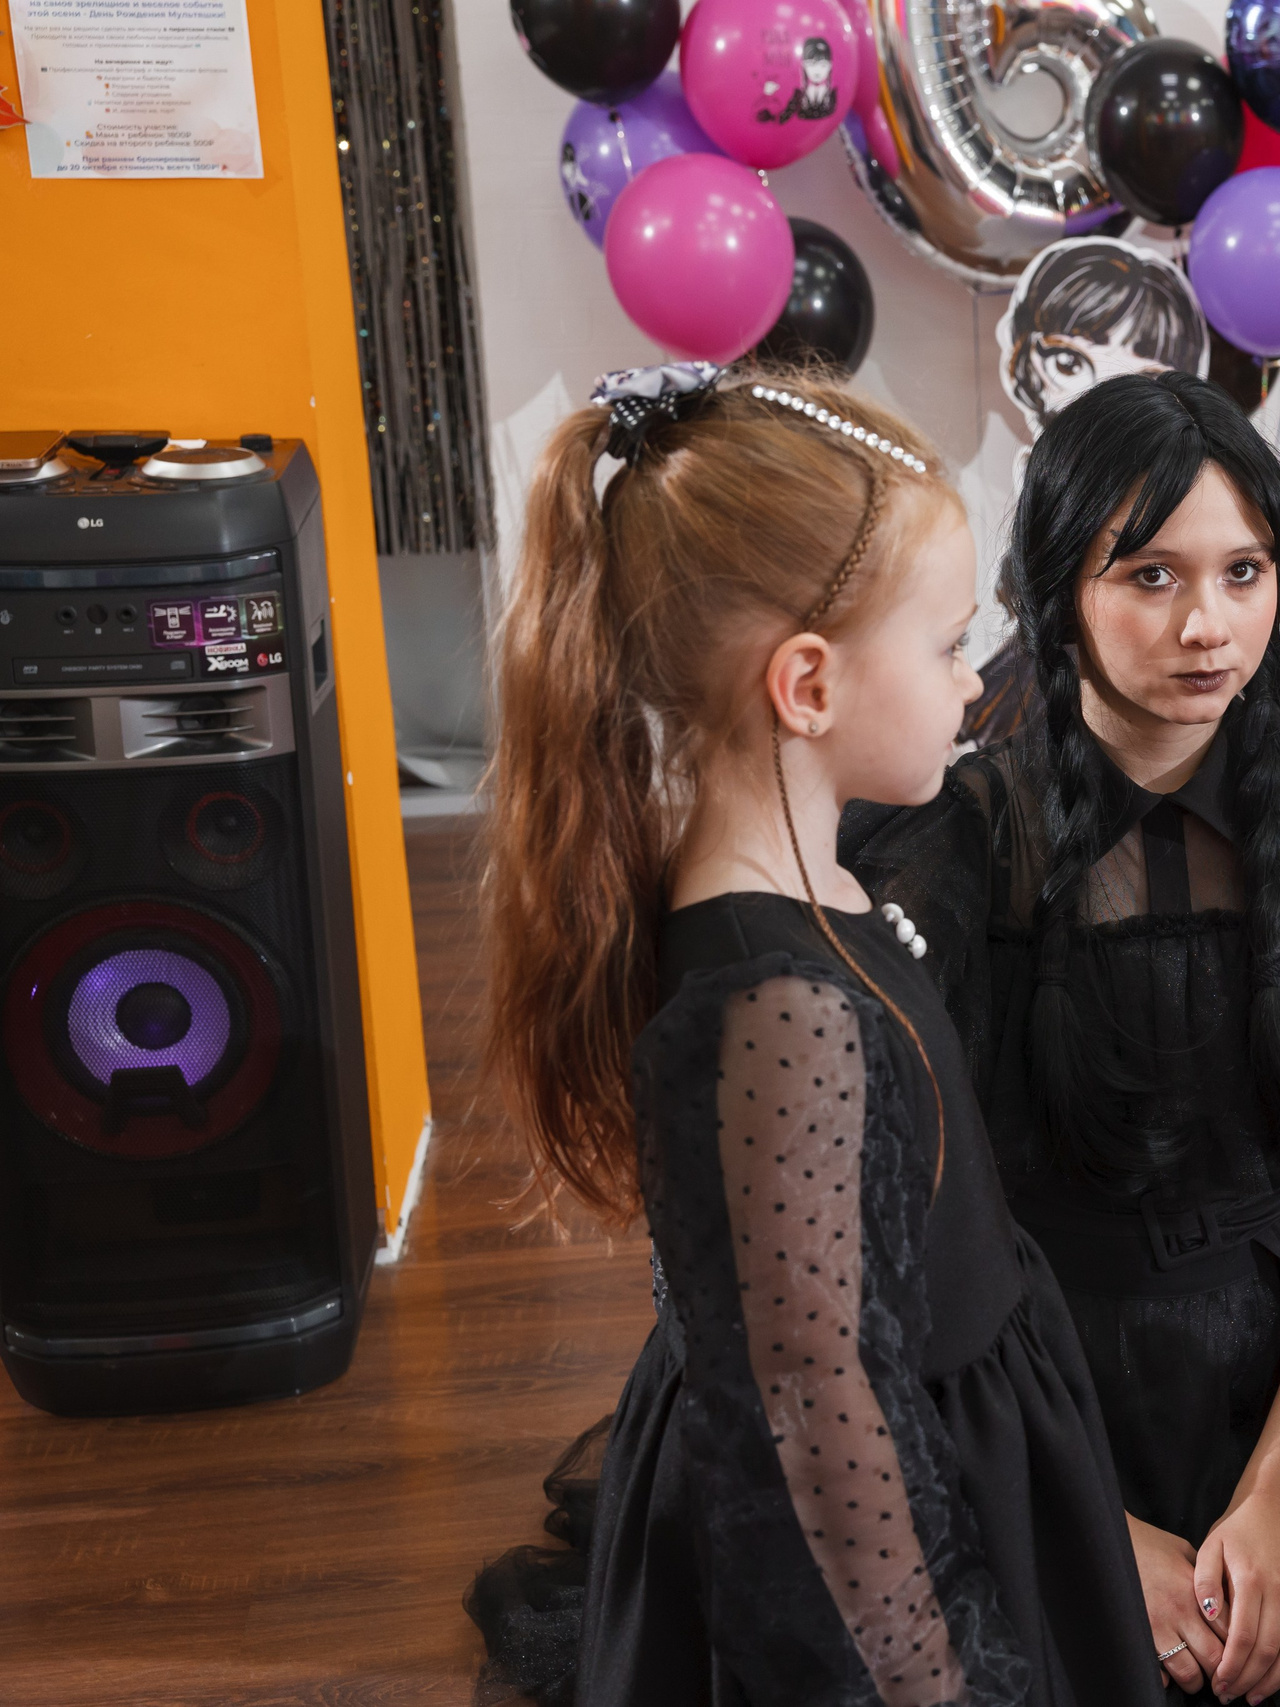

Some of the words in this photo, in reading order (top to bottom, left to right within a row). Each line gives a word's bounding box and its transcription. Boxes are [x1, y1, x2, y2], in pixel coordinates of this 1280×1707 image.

[27, 10, 49, 18] этой
[89, 10, 114, 18] День
[116, 10, 166, 18] Рождения
[90, 518, 104, 528] LG
